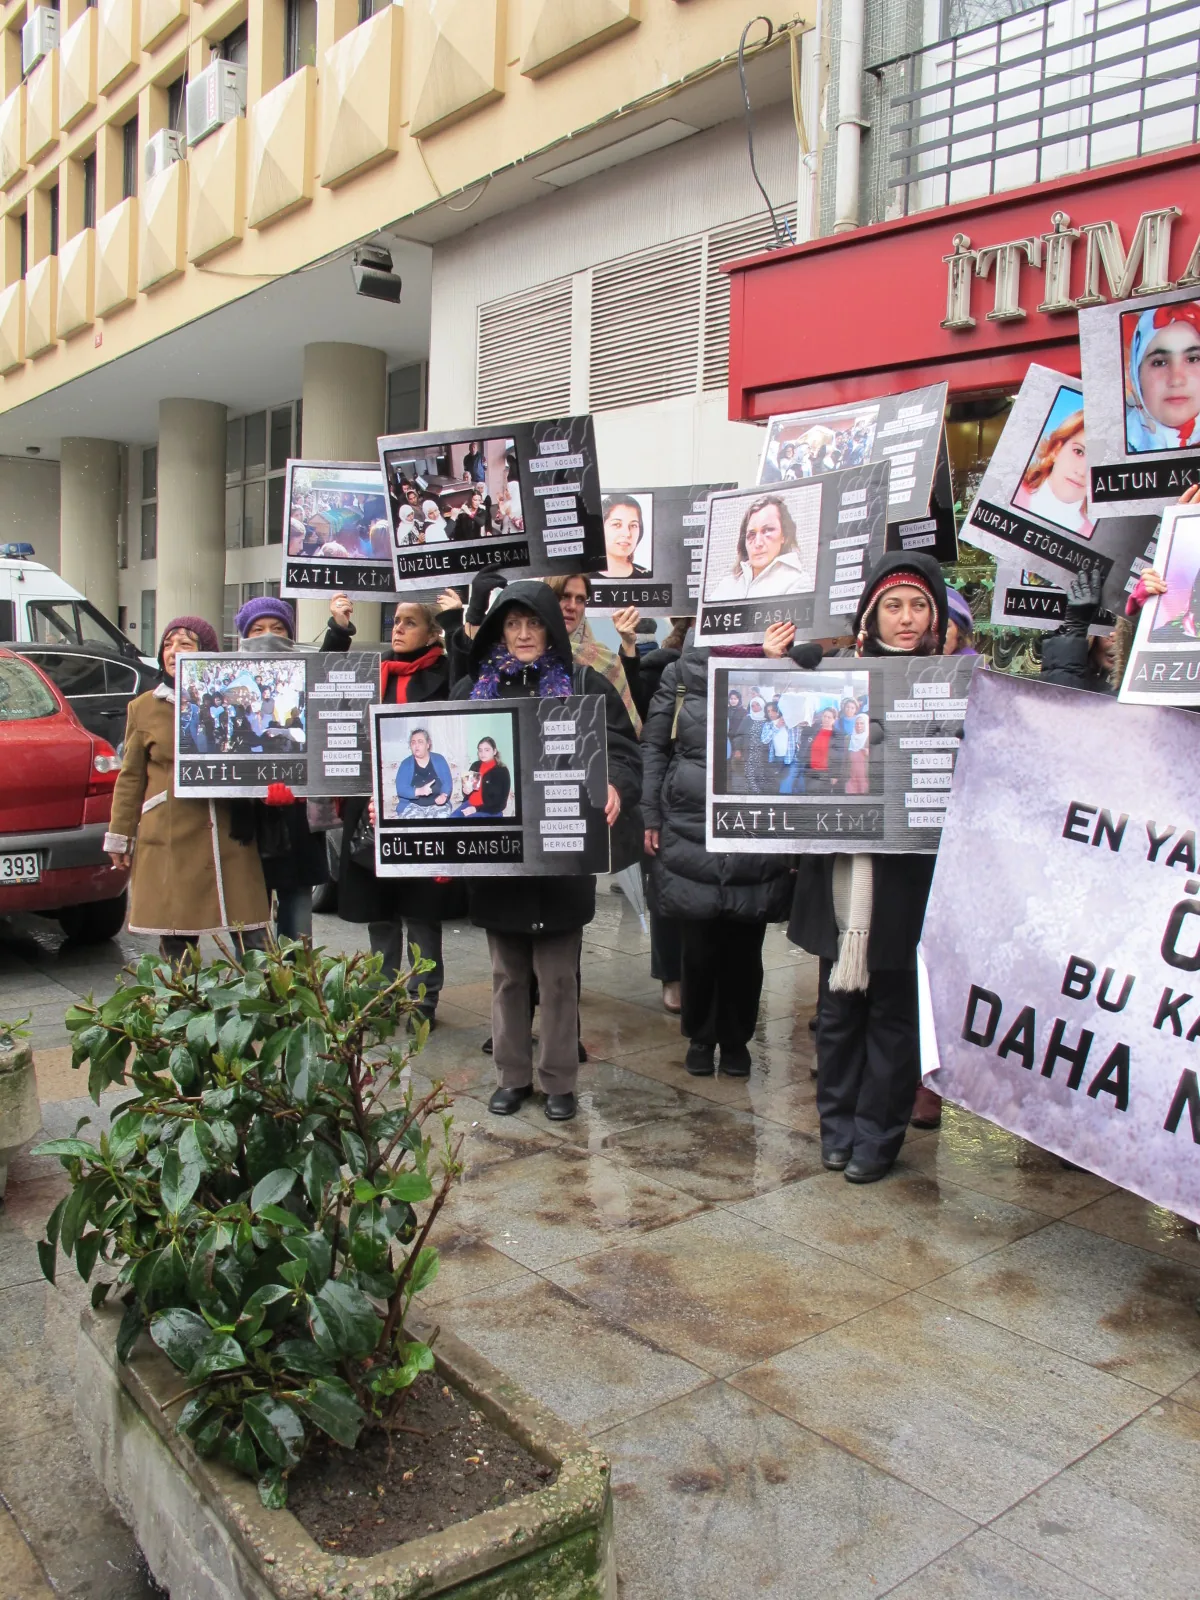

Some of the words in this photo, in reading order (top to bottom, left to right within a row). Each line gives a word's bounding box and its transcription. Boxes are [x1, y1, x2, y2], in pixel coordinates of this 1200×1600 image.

[1095, 471, 1157, 493] ALTUN
[547, 514, 576, 524] BAKAN?
[974, 507, 1019, 534] NURAY
[543, 528, 583, 539] HÜKÜMET?
[548, 544, 583, 554] HERKES?
[400, 556, 450, 573] ÜNZÜLE
[288, 567, 344, 585] KATİL
[611, 590, 671, 604] YILBAŞ
[1006, 597, 1061, 613] HAVVA
[703, 613, 742, 631] AYŞE
[1134, 662, 1200, 681] ARZU
[913, 756, 950, 765] SAVCI?
[182, 763, 242, 781] KATİL
[257, 762, 304, 780] KİM?
[326, 766, 359, 774] HERKES?
[913, 776, 950, 785] BAKAN?
[545, 787, 578, 796] SAVCI?
[546, 804, 578, 813] BAKAN?
[541, 821, 585, 831] HÜKÜMET?
[716, 808, 795, 831] KATİL
[816, 808, 879, 831] KİM?
[382, 837, 444, 857] GÜLTEN
[456, 835, 521, 855] SANSÜR
[544, 840, 583, 848] HERKES?
[1062, 800, 1130, 852] EN
[1145, 819, 1200, 875] YA
[3, 856, 36, 877] 393
[1060, 954, 1136, 1013] BU
[960, 983, 1131, 1112] DAHA
